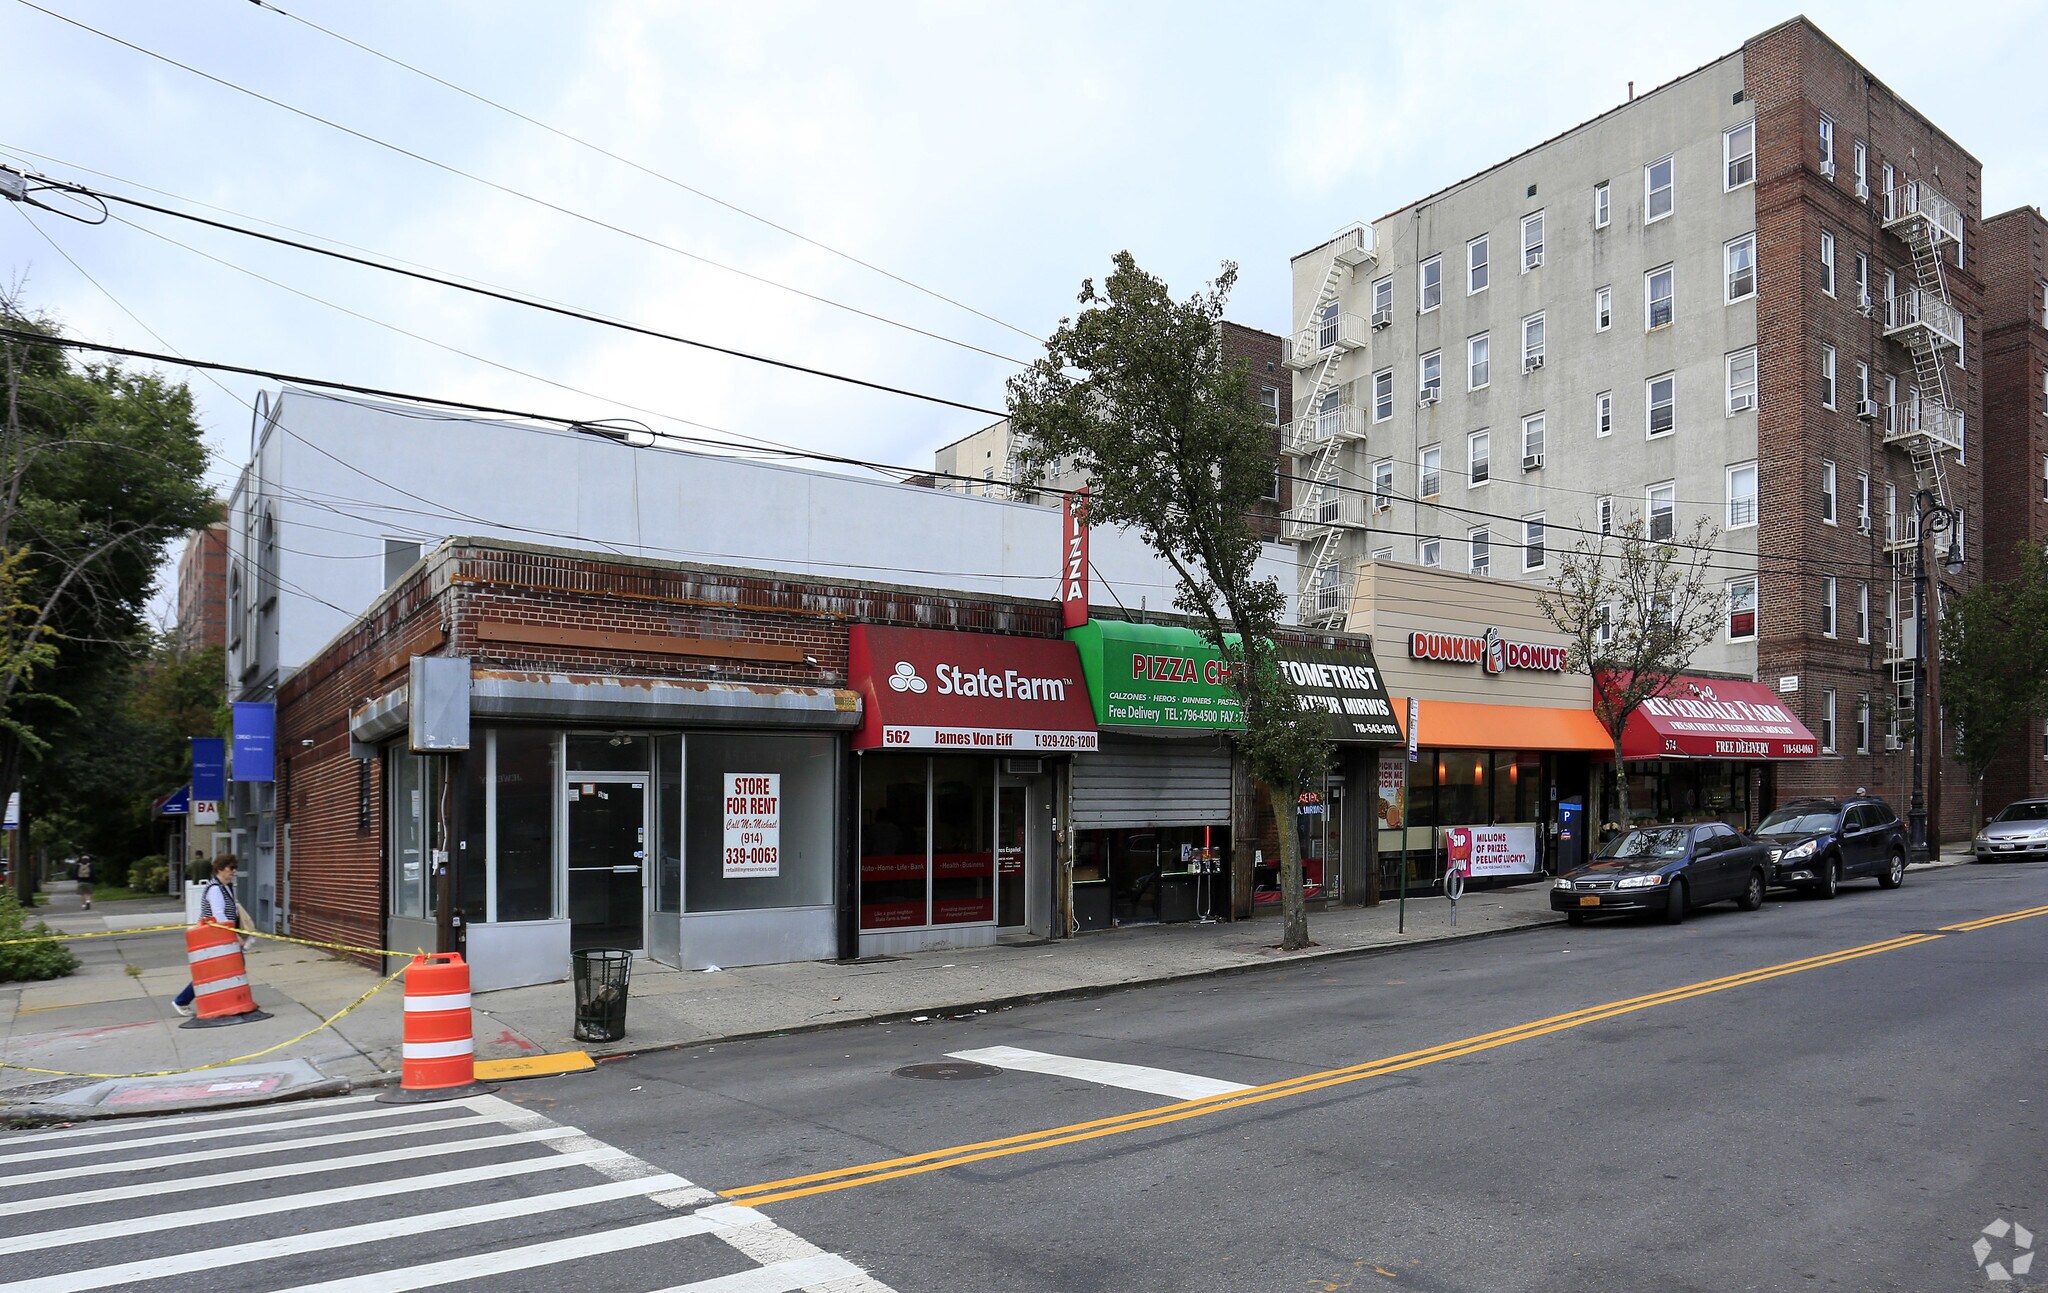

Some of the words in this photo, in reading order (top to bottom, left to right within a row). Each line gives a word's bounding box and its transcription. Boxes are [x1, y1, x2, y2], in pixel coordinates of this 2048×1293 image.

[1508, 643, 1567, 671] DONUTS
[1132, 654, 1198, 684] PIZZA
[1277, 660, 1379, 691] TOMETRIST
[1109, 692, 1147, 701] CALZONES
[1153, 694, 1177, 703] HEROS
[1182, 696, 1212, 705] DINNERS
[1291, 694, 1342, 714] RTHUR
[1344, 697, 1390, 717] MIRWIS
[1643, 694, 1745, 721] RIVERDALE
[1734, 699, 1792, 723] FARM
[1108, 704, 1126, 718] Free
[1128, 705, 1160, 723] Delivery
[1353, 722, 1398, 735] 718-543-9191
[1668, 720, 1698, 731] FRESH
[1694, 722, 1719, 731] FRUIT
[886, 730, 910, 744] 562
[934, 730, 971, 745] James
[973, 732, 994, 746] Von
[996, 733, 1013, 746] Eiff
[1665, 739, 1677, 751] 574
[1715, 740, 1735, 753] FREE
[1735, 741, 1770, 754] DELIVERY
[1378, 762, 1393, 771] PICK
[1394, 762, 1403, 770] ME
[1378, 771, 1393, 779] PICK
[1394, 771, 1403, 779] ME
[735, 777, 770, 795] STORE
[1378, 780, 1393, 788] PICK
[1394, 780, 1403, 788] ME
[726, 797, 747, 815] FOR
[750, 797, 777, 815] RENT
[1564, 811, 1571, 821] P
[726, 818, 740, 831] Call
[753, 818, 778, 829] Michael
[741, 832, 763, 846] (914)
[1453, 834, 1466, 847] SIP
[1476, 833, 1507, 843] MILLIONS
[1475, 845, 1485, 853] OF
[1487, 844, 1509, 853] PRIZES.
[726, 847, 777, 864] 339-0063
[1475, 855, 1503, 864] PEELING
[1503, 853, 1526, 863] LUCKY?
[861, 864, 874, 872] Auto
[962, 861, 985, 869] Business
